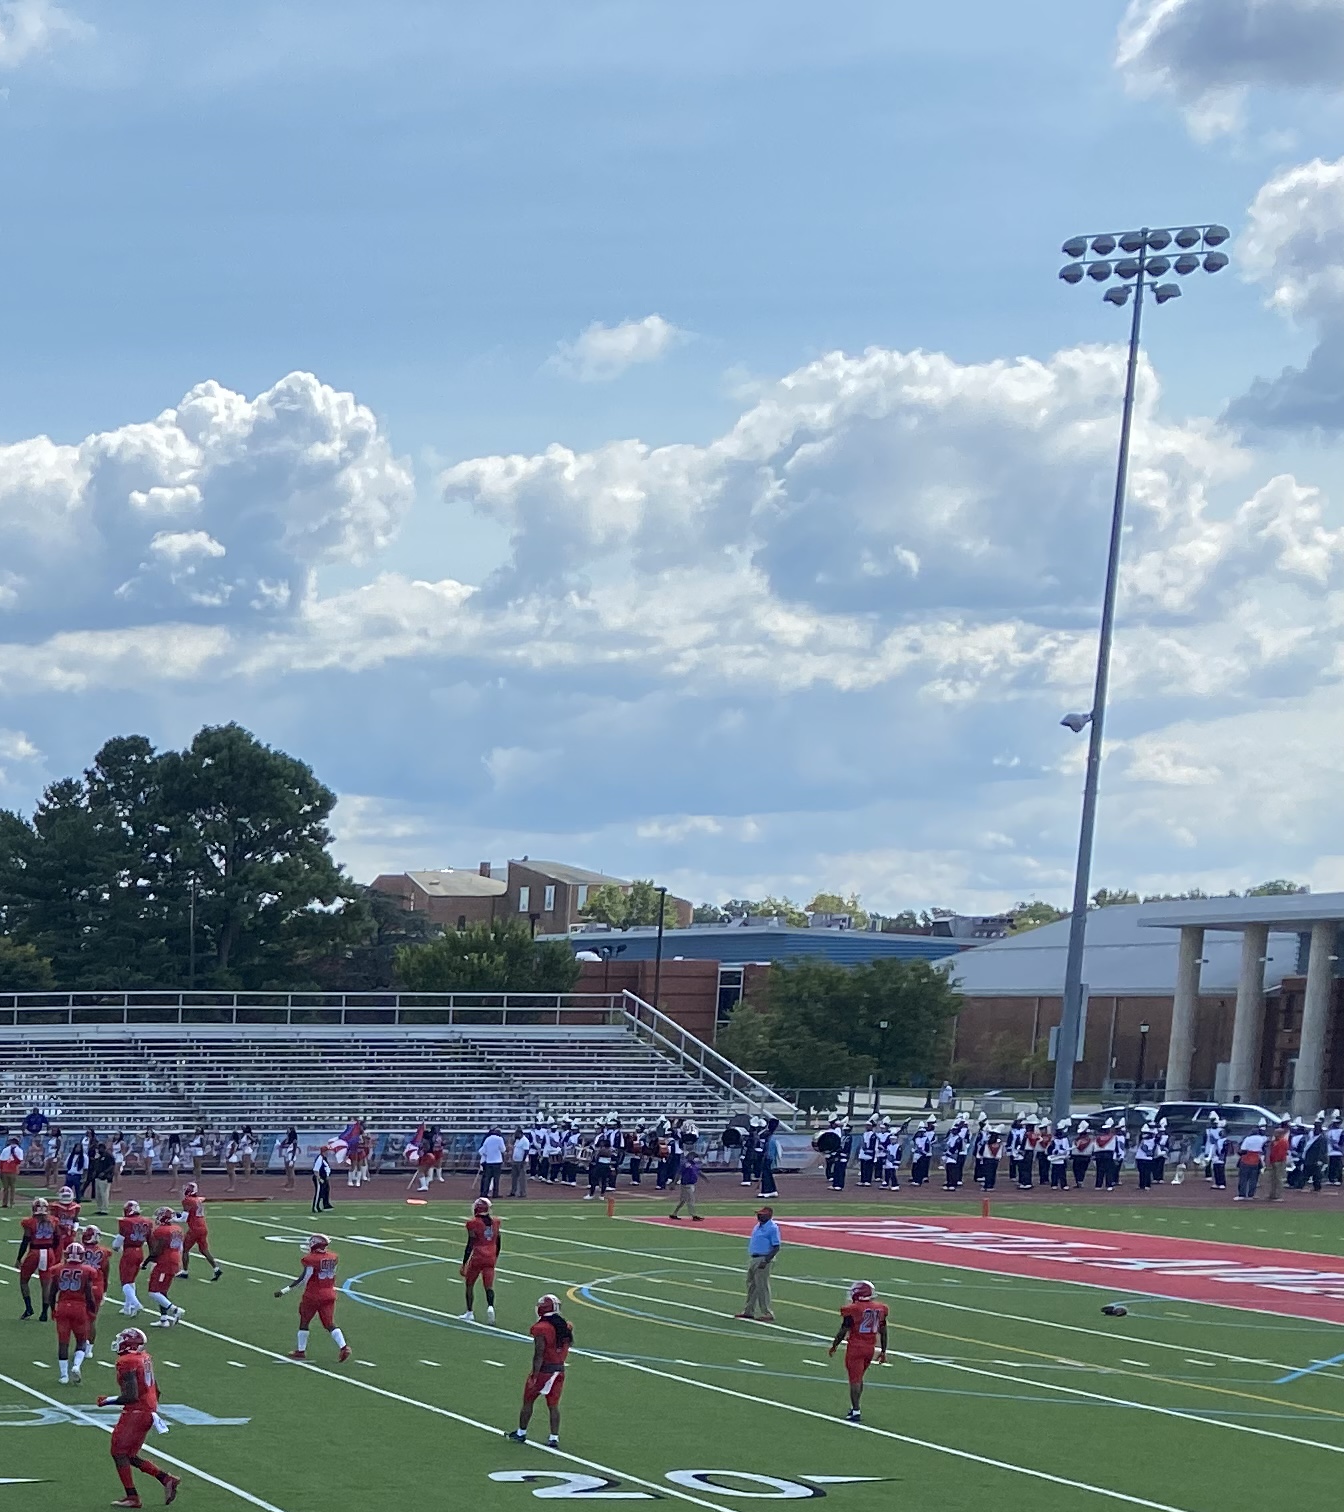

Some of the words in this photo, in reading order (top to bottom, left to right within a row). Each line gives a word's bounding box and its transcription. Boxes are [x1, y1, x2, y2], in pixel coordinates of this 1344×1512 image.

[59, 1268, 83, 1291] 55
[859, 1308, 880, 1333] 21
[487, 1468, 828, 1500] 20
